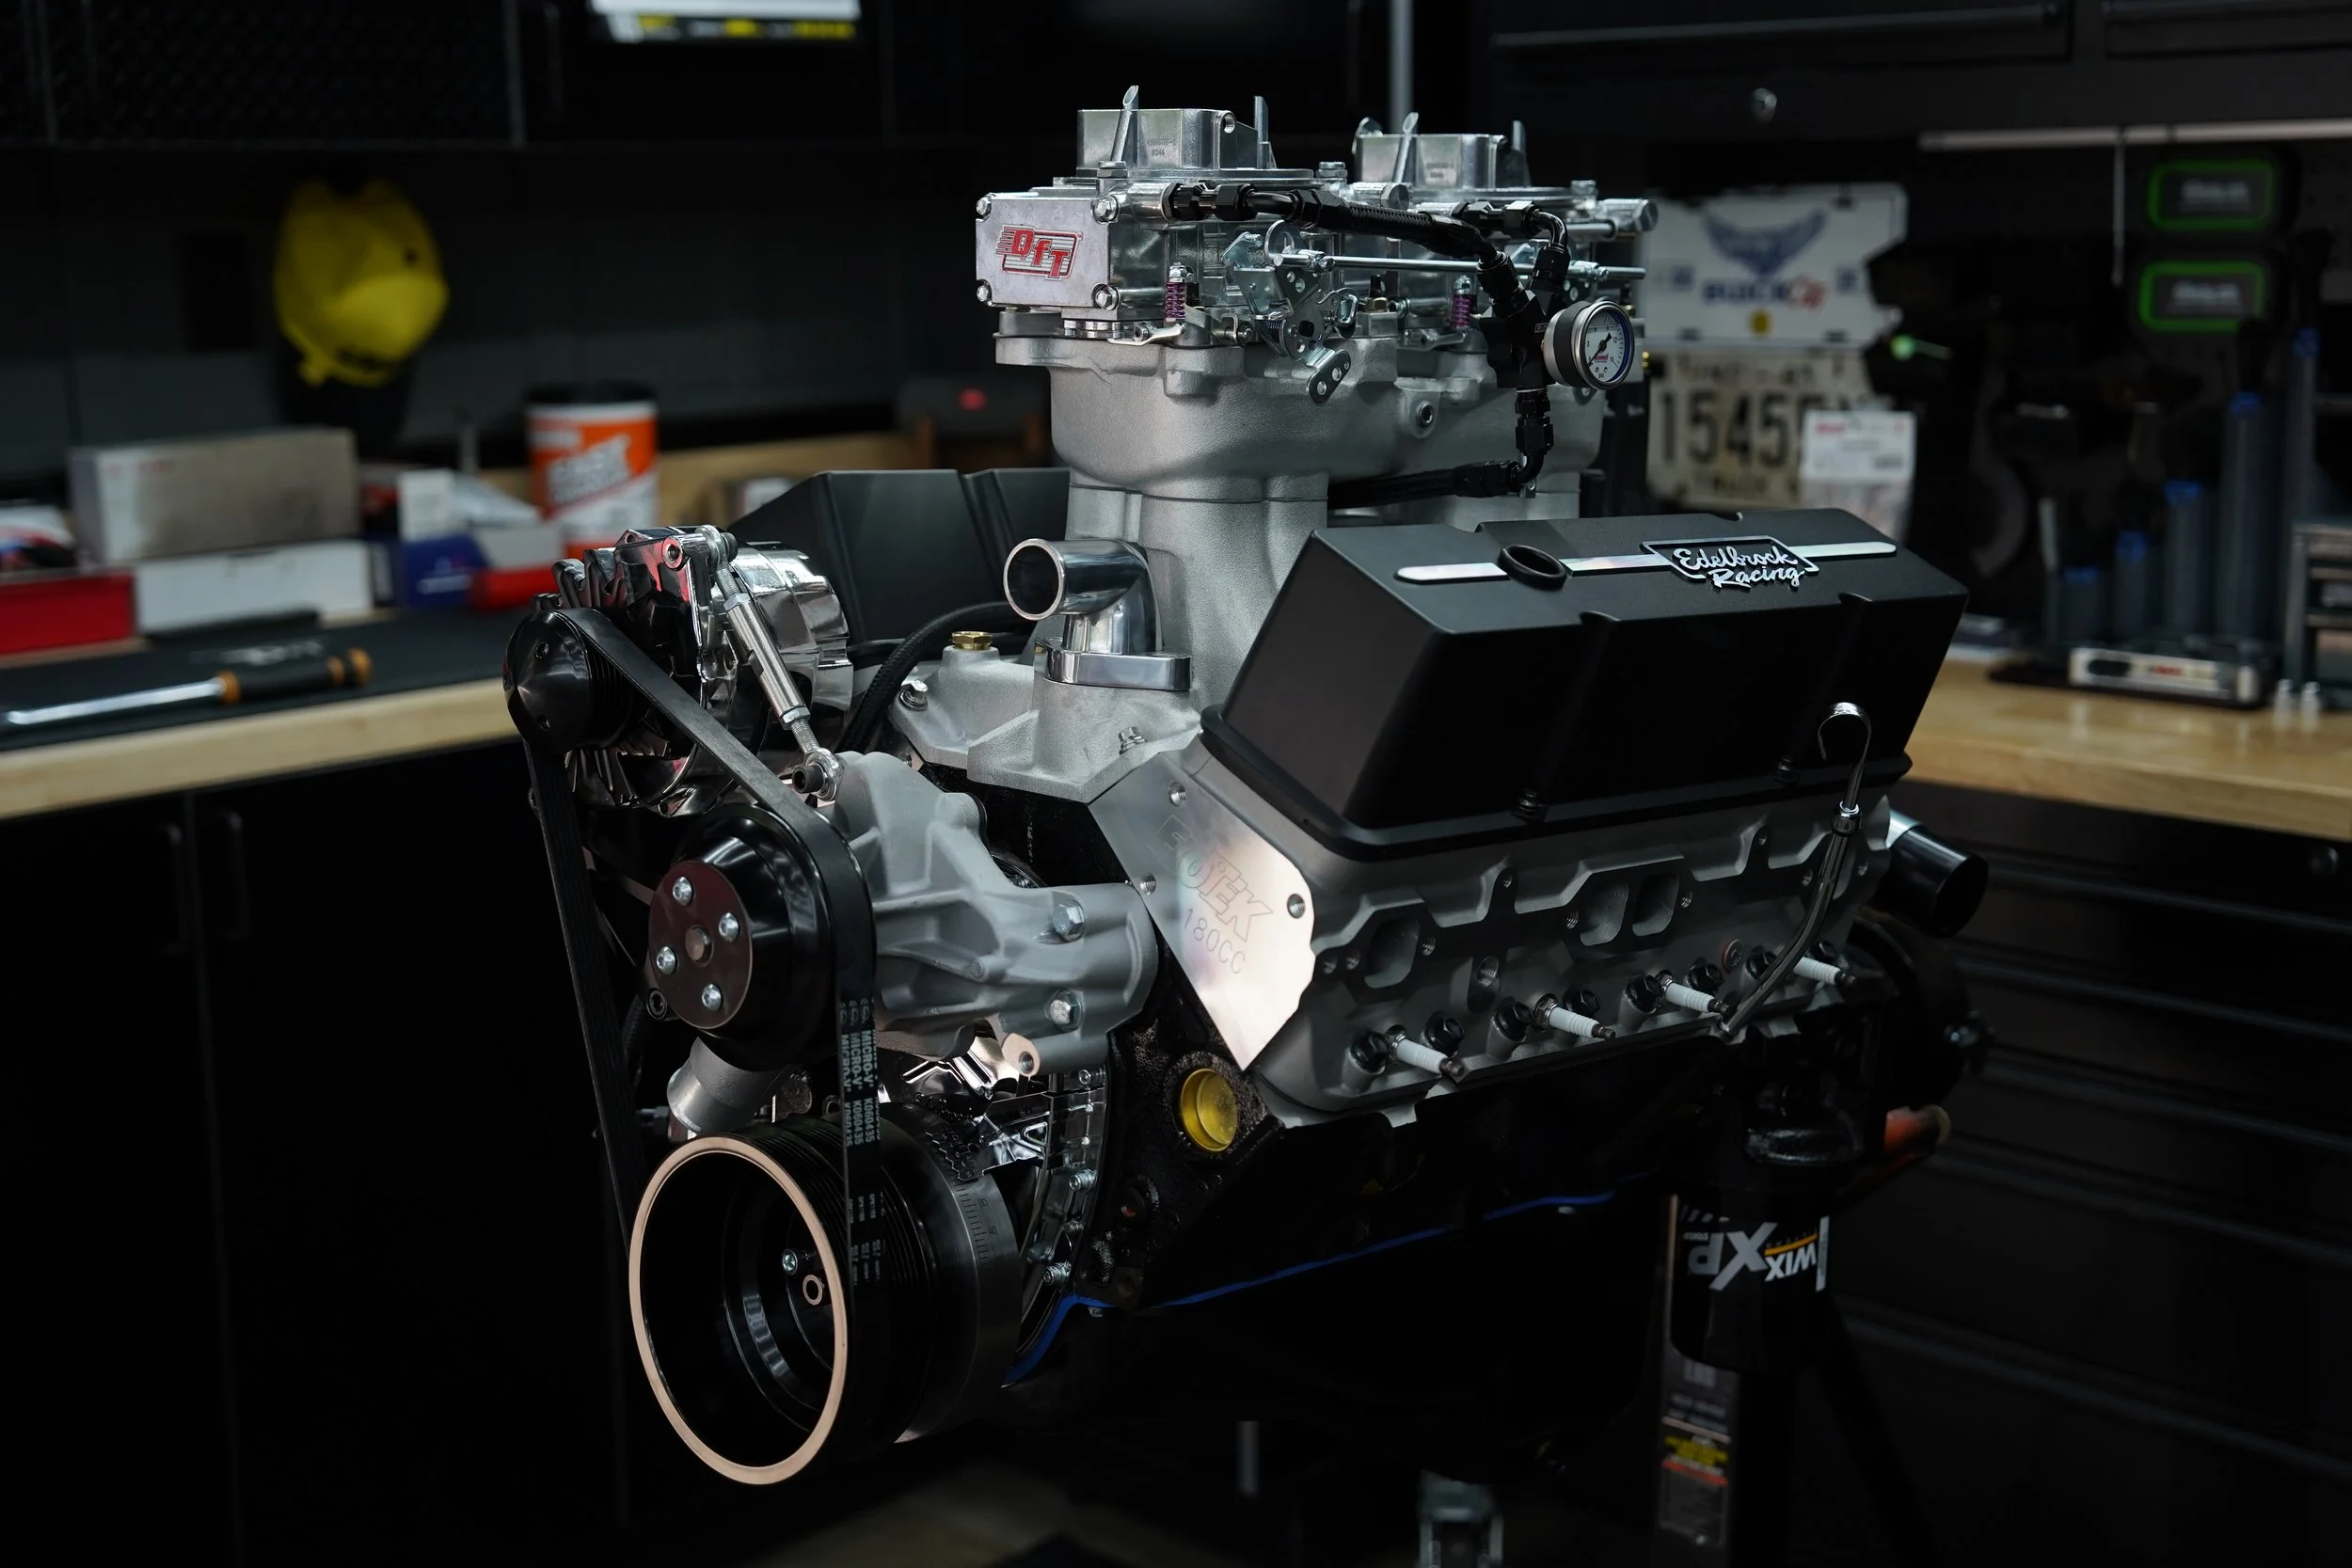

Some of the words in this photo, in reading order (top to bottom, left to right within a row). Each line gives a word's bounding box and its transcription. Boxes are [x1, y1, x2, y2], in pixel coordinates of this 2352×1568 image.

[1673, 546, 1798, 570] Edelbrock
[1708, 566, 1804, 588] Racing
[1184, 909, 1246, 974] 180CC
[852, 1099, 865, 1146] K060435
[863, 1097, 876, 1144] K060435
[1687, 1222, 1779, 1291] XP
[1764, 1242, 1817, 1283] WIX
